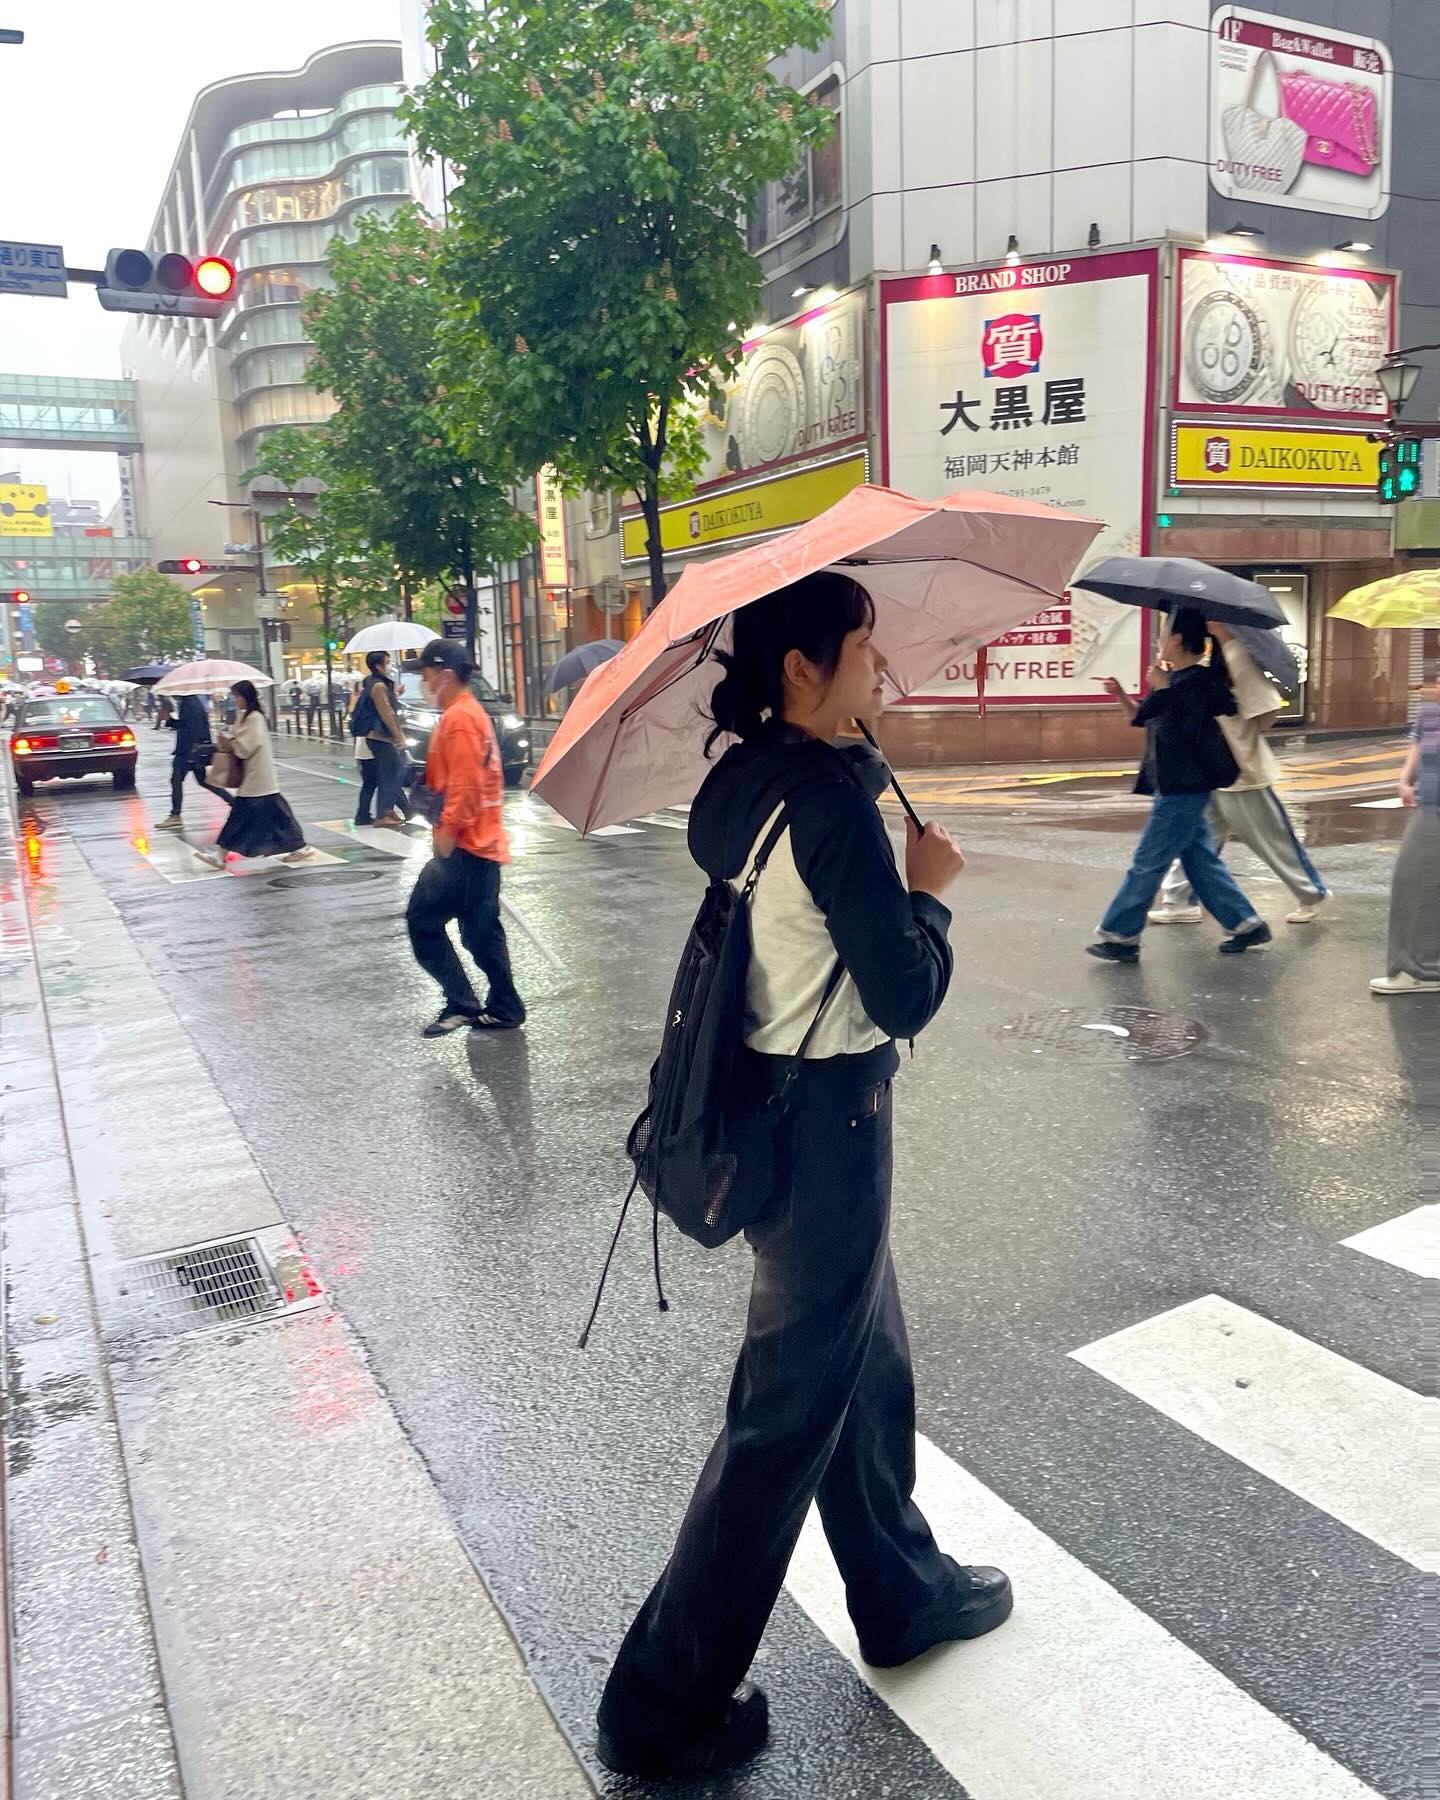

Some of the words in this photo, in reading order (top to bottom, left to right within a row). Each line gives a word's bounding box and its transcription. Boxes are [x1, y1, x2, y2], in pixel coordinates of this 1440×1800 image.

[1272, 32, 1334, 60] Bag&Wallet
[1216, 159, 1250, 177] DUTY
[1251, 164, 1282, 182] FREE
[955, 270, 1016, 294] BRAND
[1020, 264, 1071, 286] SHOP
[986, 321, 1038, 371] 質
[939, 377, 1086, 436] 大黒屋
[1295, 382, 1341, 402] DUTY
[1344, 386, 1383, 406] FREE
[798, 421, 825, 447] DUTY
[827, 411, 856, 435] FREE
[944, 443, 1080, 479] 福岡天神本館
[1206, 442, 1229, 468] 質
[1240, 446, 1362, 472] DAIKOKUYA
[945, 662, 1011, 681] DUTY
[1014, 660, 1074, 680] FREE
